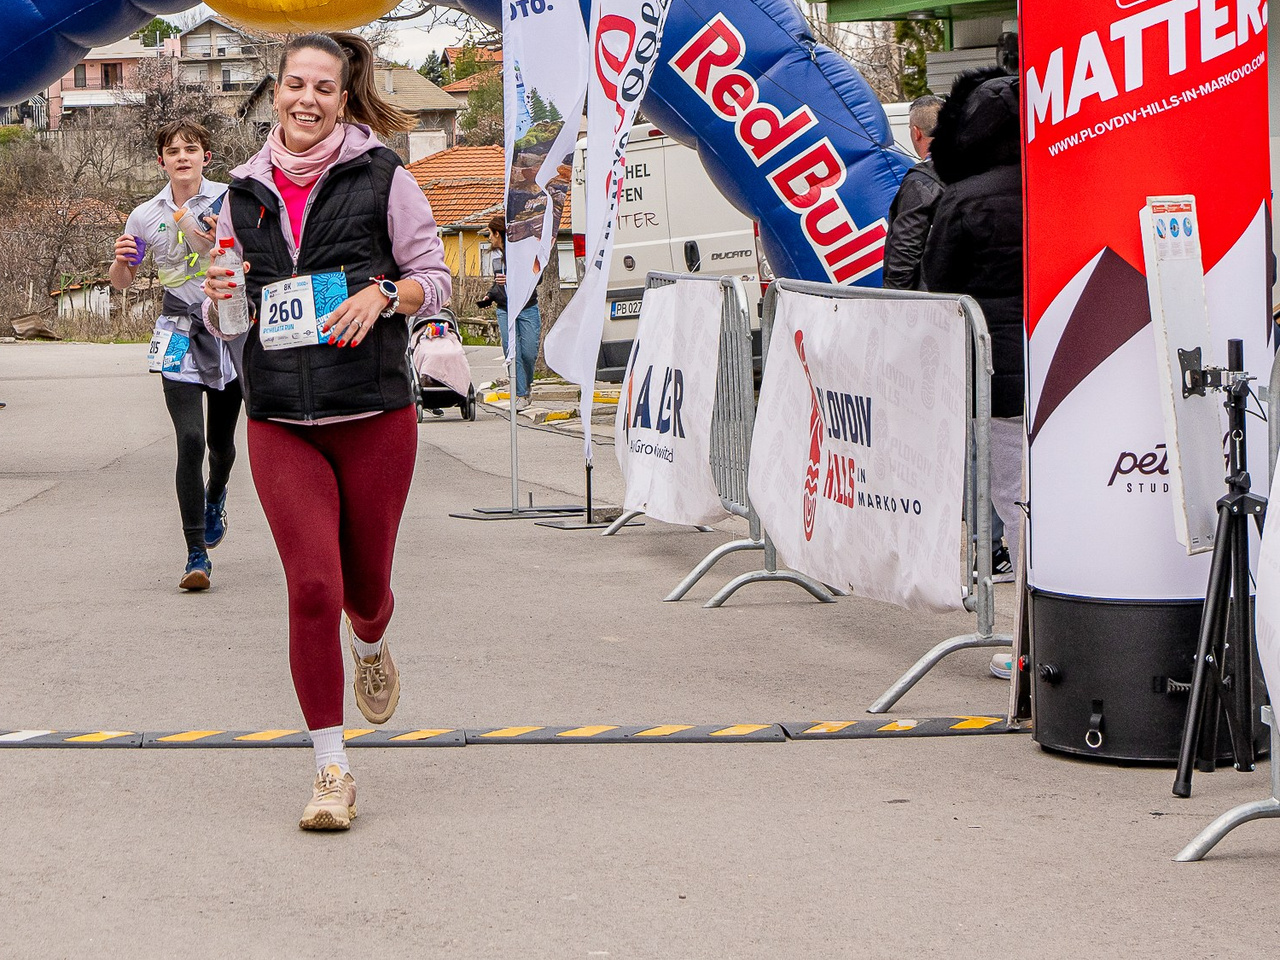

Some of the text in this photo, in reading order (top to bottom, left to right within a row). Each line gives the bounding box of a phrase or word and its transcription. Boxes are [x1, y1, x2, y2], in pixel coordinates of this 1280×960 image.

[1048, 50, 1266, 157] WWW.PLOVDIV-HILLS-IN-MARKOVO.COM
[674, 18, 887, 284] Red Bull
[623, 163, 651, 178] HEL
[711, 249, 753, 261] DUCATO
[268, 298, 303, 325] 260
[857, 467, 866, 484] IN
[857, 491, 922, 515] MARKOVO
